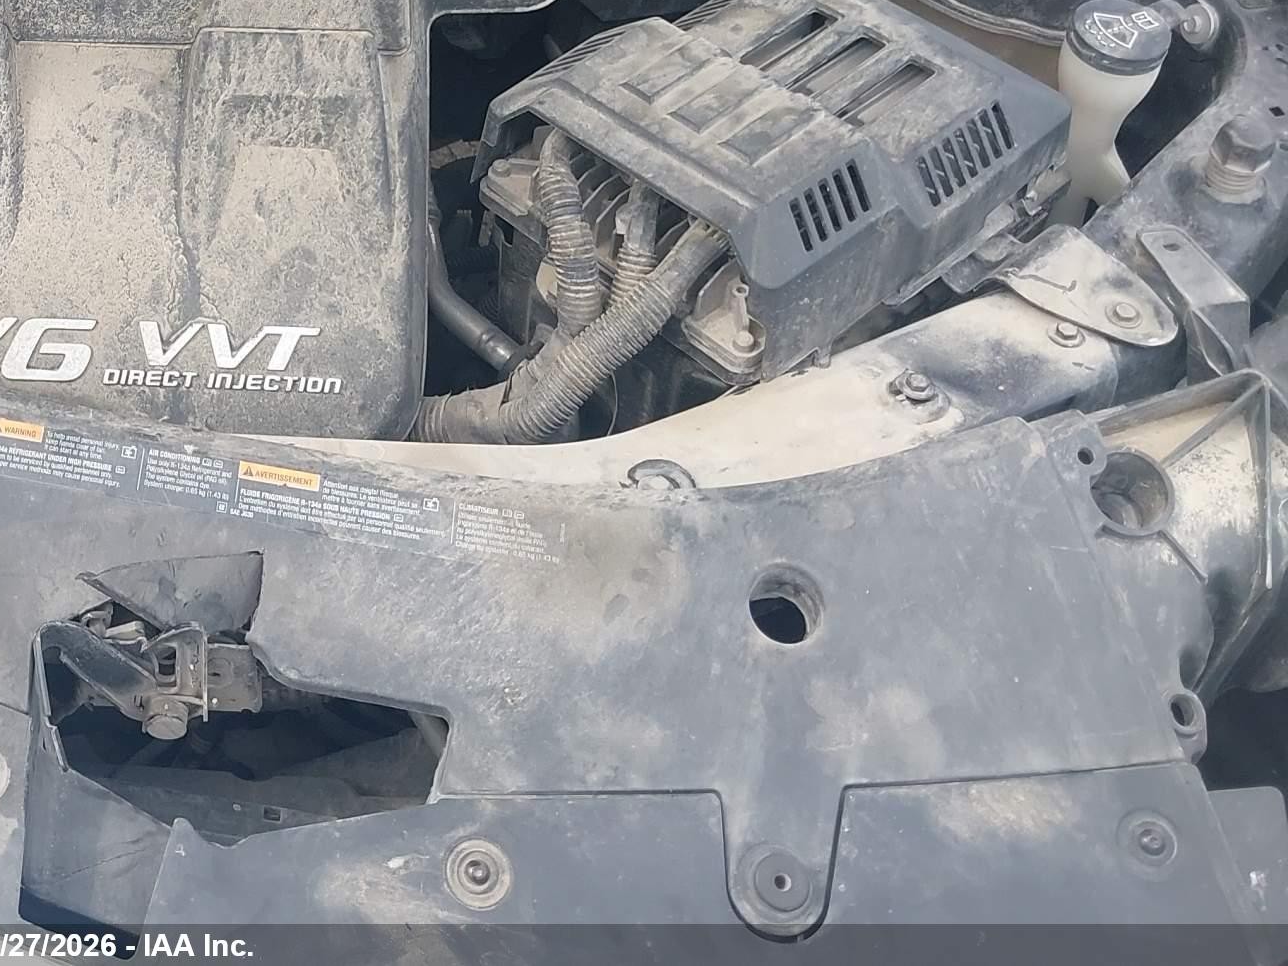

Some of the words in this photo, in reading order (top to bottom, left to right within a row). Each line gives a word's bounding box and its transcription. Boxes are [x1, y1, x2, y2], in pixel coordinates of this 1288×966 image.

[140, 320, 321, 371] VVT
[103, 369, 197, 386] DIRECT
[208, 374, 342, 394] INJECTION
[4, 426, 37, 438] WARNING
[8, 446, 46, 460] REFRIGERANT
[48, 454, 66, 463] UNDER
[82, 460, 112, 472] PRESSURE
[79, 450, 89, 459] any
[148, 449, 159, 458] AIR
[160, 450, 200, 464] CONDITIONING
[44, 460, 50, 468] by
[158, 460, 170, 468] only
[146, 472, 155, 480] The
[254, 470, 312, 486] AVERTISSEMENT
[199, 490, 206, 498] kg
[240, 488, 261, 498] FLUIDE
[322, 502, 338, 511] SOUS
[340, 504, 360, 514] HAUTE
[360, 508, 391, 520] PRESSION
